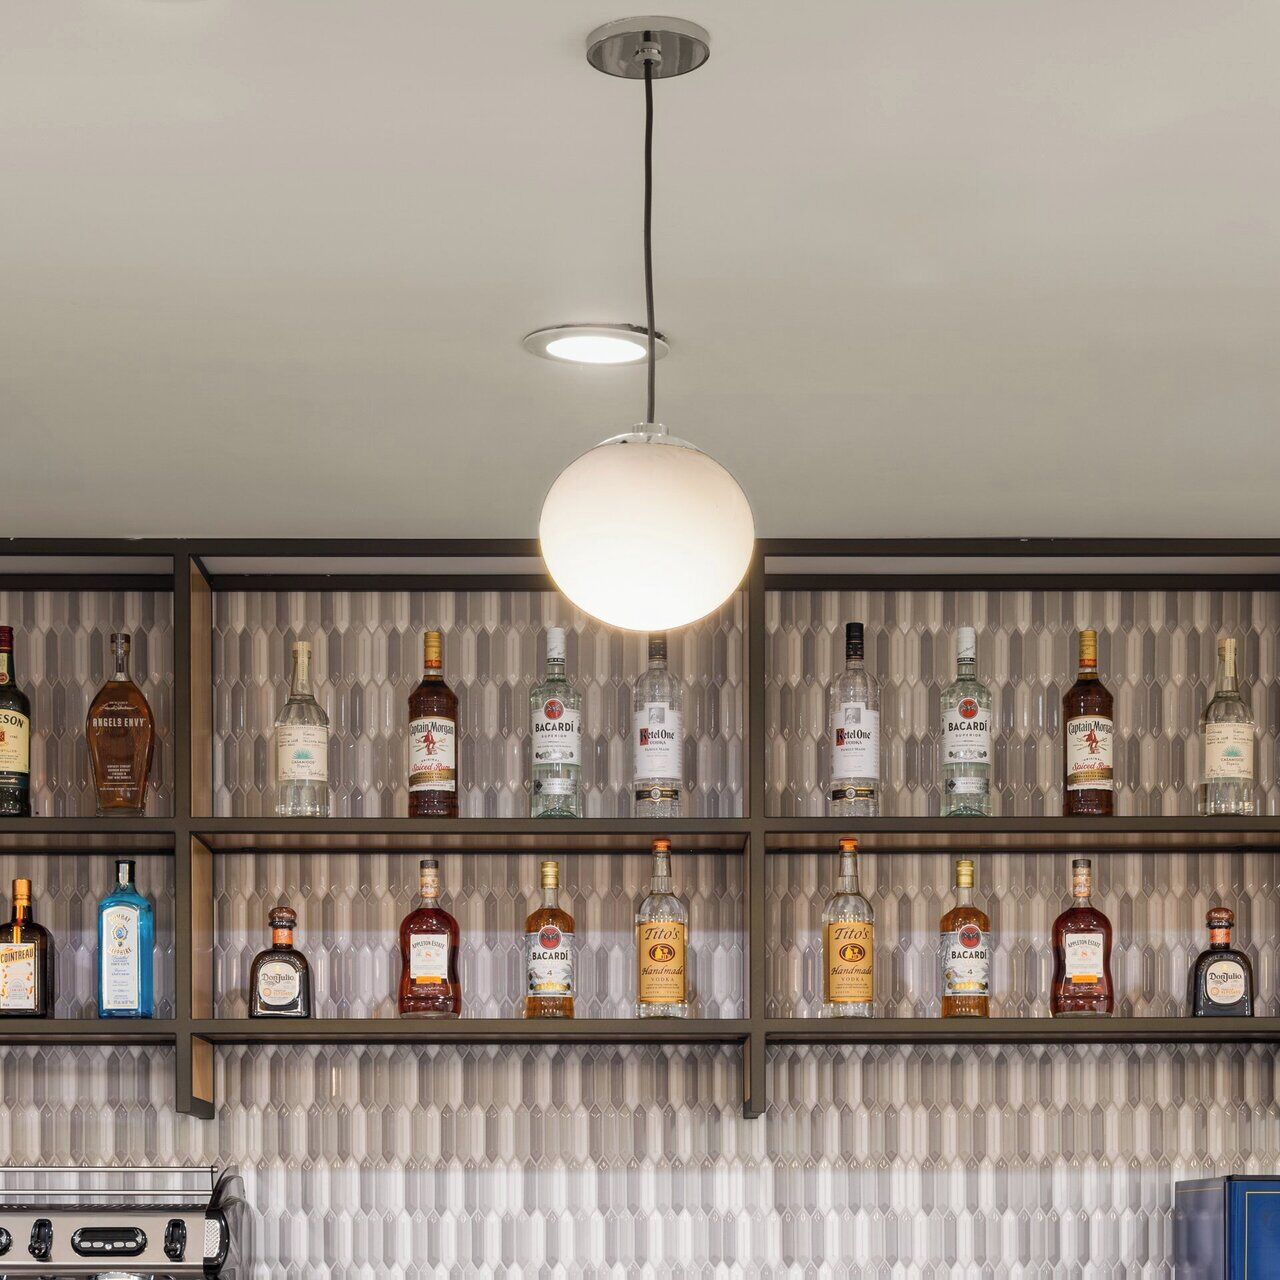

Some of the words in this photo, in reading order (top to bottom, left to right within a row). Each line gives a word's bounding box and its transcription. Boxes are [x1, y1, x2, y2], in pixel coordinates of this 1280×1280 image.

[124, 718, 144, 727] ENVY
[948, 719, 988, 732] BACARDÍ
[1069, 720, 1092, 736] Captain
[1093, 720, 1112, 735] Morga
[639, 728, 660, 743] Ketel
[660, 729, 675, 740] One
[836, 728, 856, 743] Ketel
[856, 729, 870, 740] One
[411, 762, 433, 773] Spiced
[1072, 761, 1096, 771] Spiced
[644, 926, 680, 941] Tito's
[834, 926, 870, 940] Tito's
[0, 947, 34, 964] COINTREAU
[532, 949, 569, 961] BACARDÍ
[951, 948, 987, 960] BACARDÍ
[1209, 972, 1225, 980] Don
[1222, 972, 1242, 983] Julio
